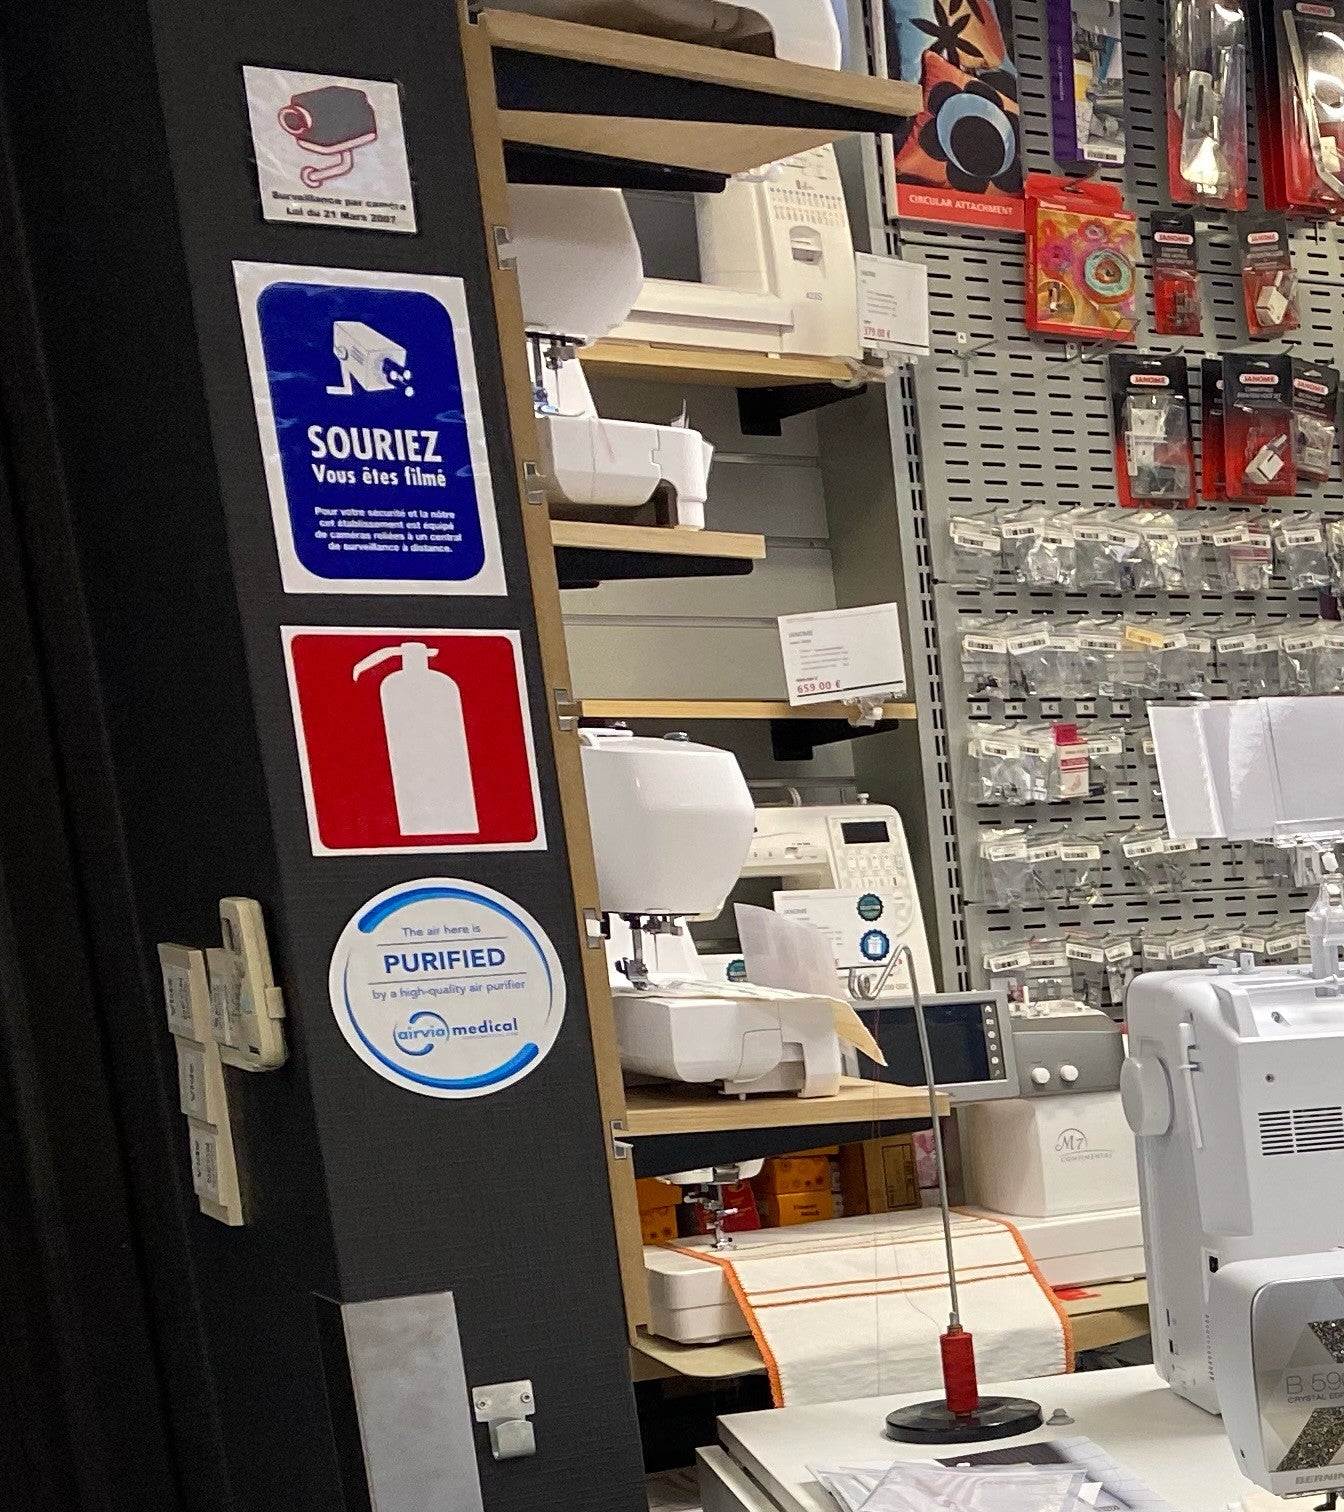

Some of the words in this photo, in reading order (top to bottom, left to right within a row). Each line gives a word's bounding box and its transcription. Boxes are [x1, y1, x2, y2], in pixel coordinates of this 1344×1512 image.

[272, 190, 342, 205] Surveillance
[345, 199, 362, 207] par
[365, 201, 407, 211] caméra
[908, 194, 953, 208] CIRCULAR
[955, 199, 1014, 216] ATTACHMENT
[286, 207, 303, 217] Loi
[307, 208, 321, 217] du
[323, 209, 336, 219] 21
[340, 211, 367, 222] Mars
[370, 213, 396, 224] 2007
[307, 424, 443, 463] SOURIEZ
[311, 463, 357, 484] Vous
[361, 466, 399, 485] êtes
[404, 465, 447, 488] filmé
[314, 506, 339, 516] Pour
[341, 508, 365, 517] votre
[367, 508, 406, 518] sécurité
[407, 510, 418, 518] et
[419, 510, 429, 519] la
[430, 510, 456, 519] nôtre
[318, 520, 336, 528] cet
[337, 519, 404, 529] établissement
[405, 521, 421, 530] est
[423, 521, 455, 531] équipé
[314, 530, 328, 539] de
[329, 531, 372, 541] caméras
[373, 531, 406, 541] reliées
[415, 533, 429, 541] un
[327, 542, 341, 551] de
[343, 542, 400, 552] surveillance
[402, 543, 409, 552] à
[410, 544, 454, 553] distance.
[835, 679, 841, 689] €
[401, 926, 424, 938] The
[427, 927, 441, 936] air
[443, 926, 469, 935] here
[471, 924, 481, 934] is
[383, 947, 506, 974] PURIFIED
[372, 989, 387, 1002] by
[390, 990, 398, 999] a
[400, 985, 467, 1000] high-quality
[468, 984, 483, 993] air
[486, 980, 526, 994] purifier
[397, 1024, 446, 1040] airvia
[451, 1017, 519, 1036] medical
[1054, 1135, 1085, 1152] M7
[1286, 1375, 1304, 1395] B
[1287, 1392, 1326, 1404] CRYSTAL
